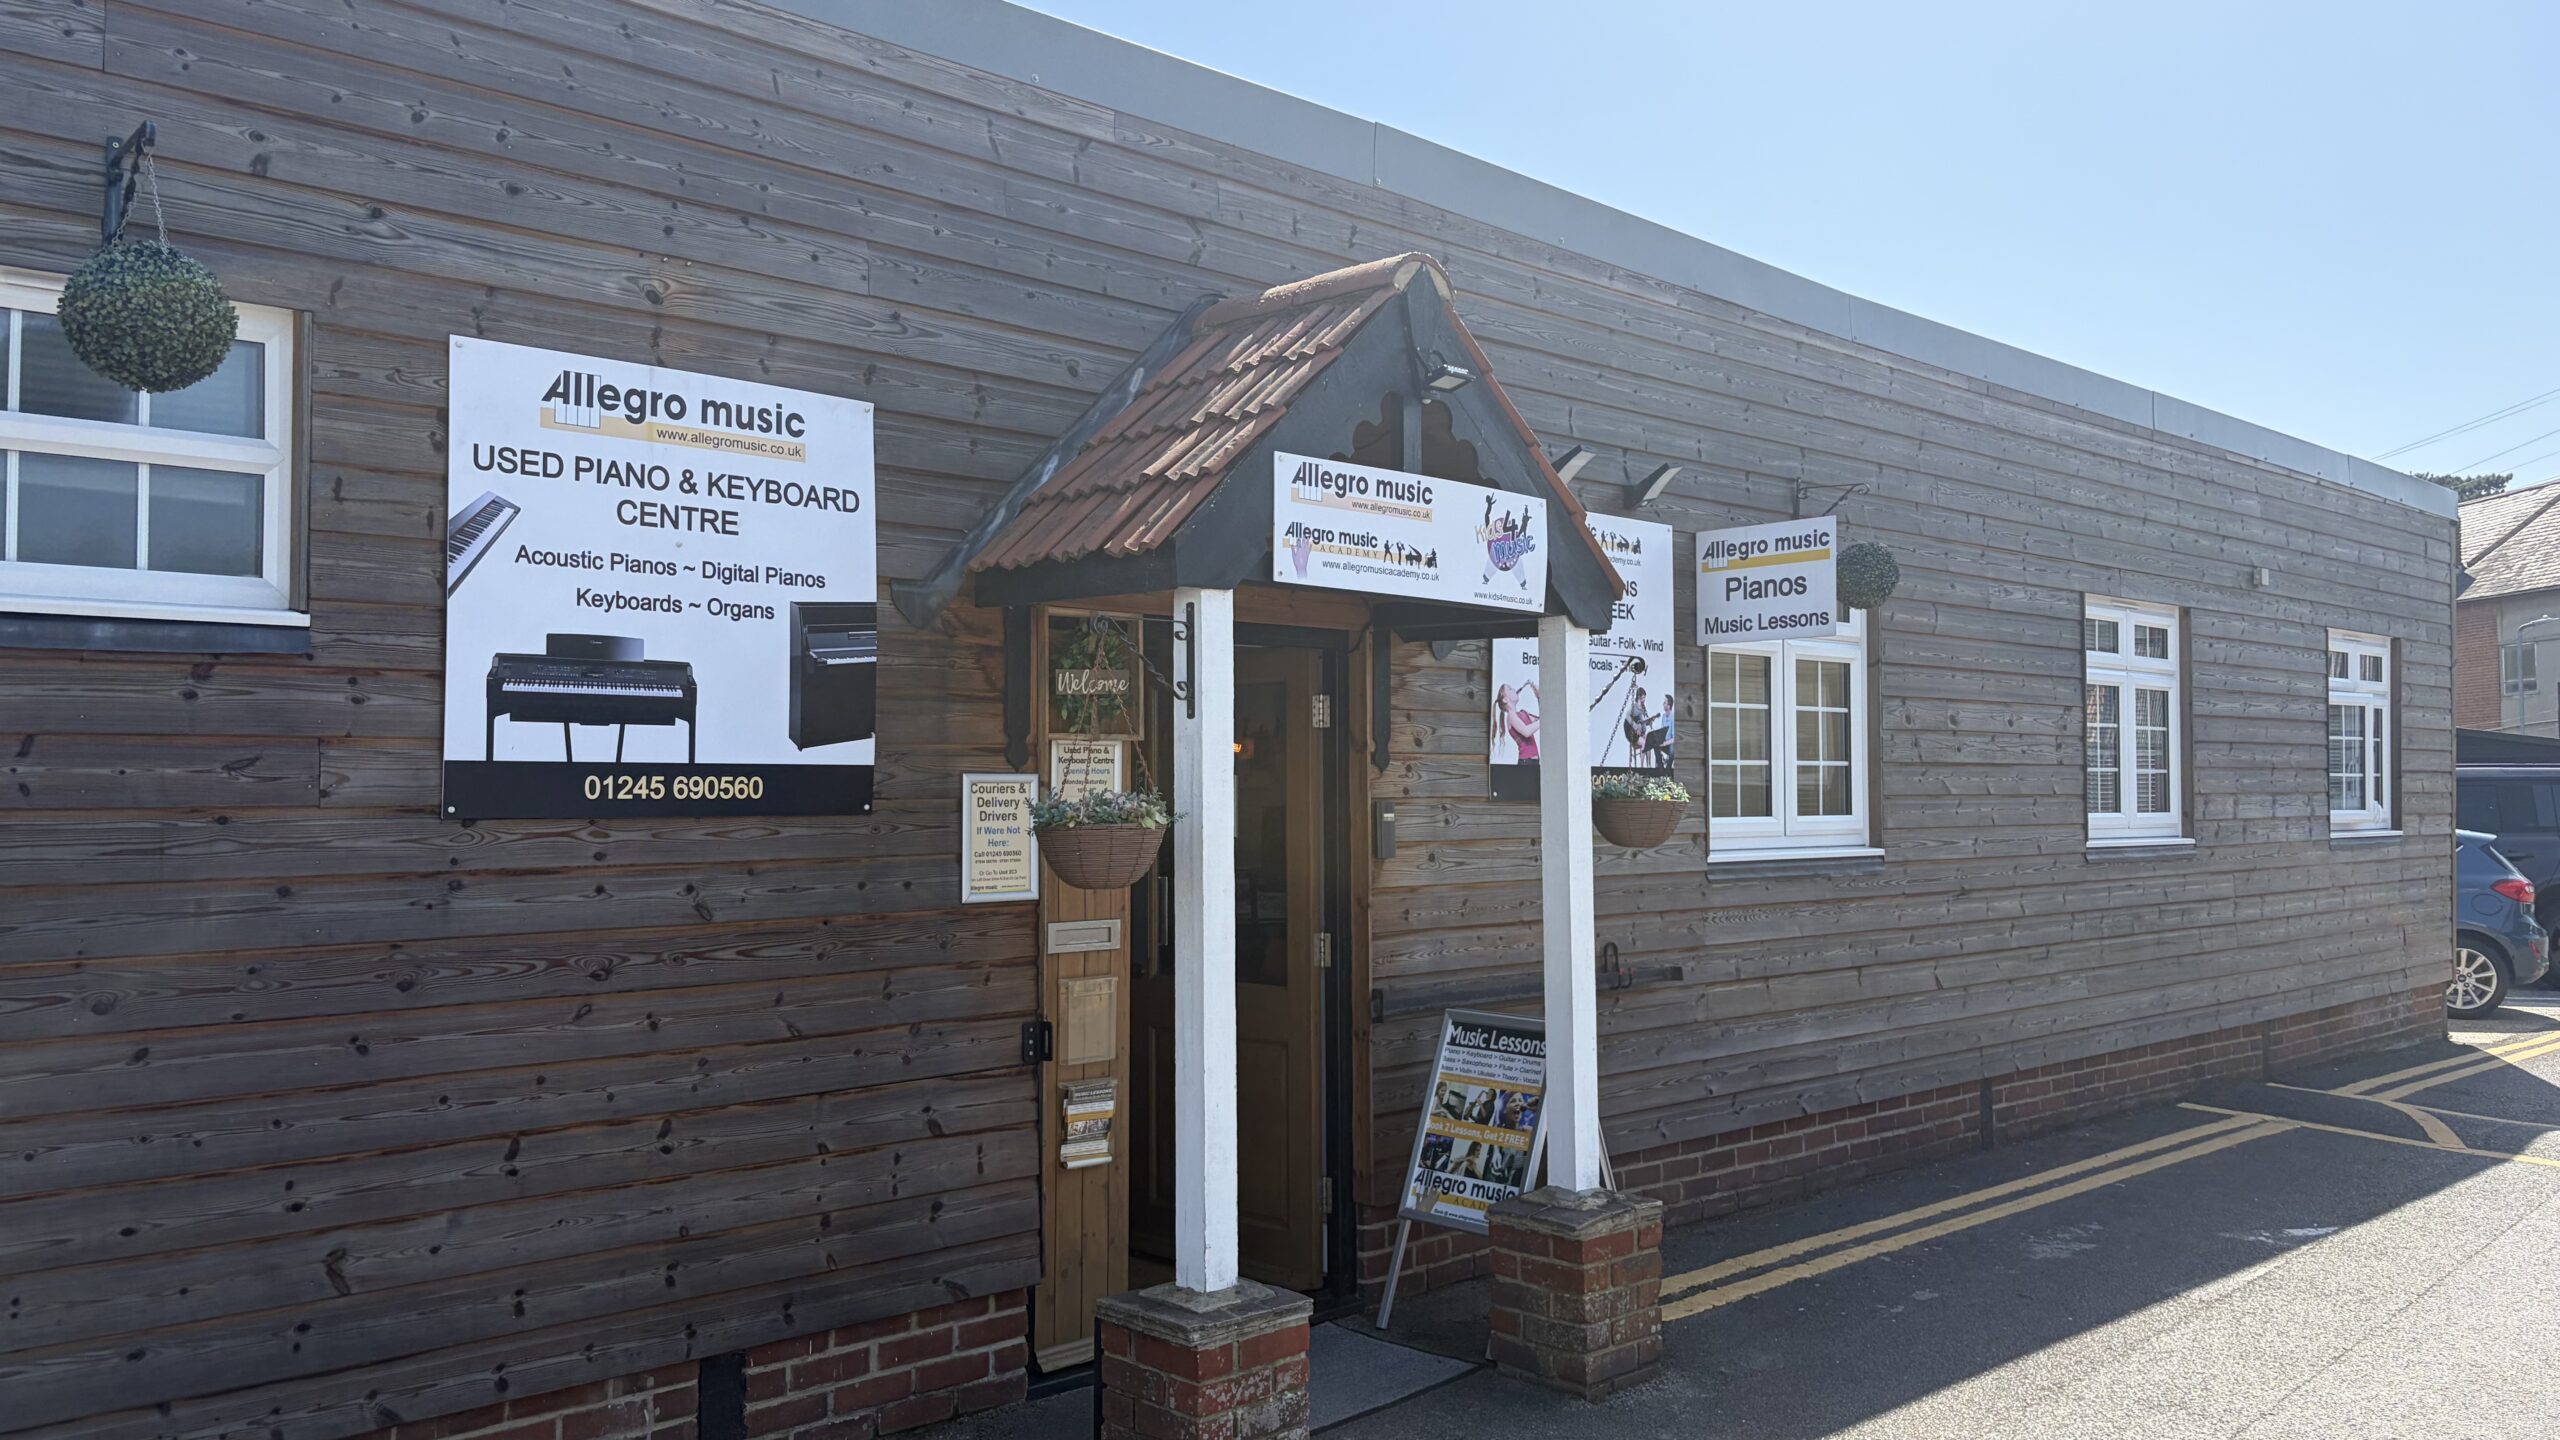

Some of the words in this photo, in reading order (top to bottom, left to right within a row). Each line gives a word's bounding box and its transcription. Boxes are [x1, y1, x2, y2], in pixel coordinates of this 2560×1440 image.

[541, 370, 687, 425] Allegro
[701, 394, 805, 438] music
[657, 427, 802, 459] www.allegromusic.co.uk
[472, 443, 564, 478] USED
[575, 456, 670, 491] PIANO
[679, 469, 698, 495] &
[707, 473, 860, 513] KEYBOARD
[1292, 461, 1368, 498] Allegro
[1376, 478, 1433, 505] music
[617, 500, 740, 536] CENTRE
[1352, 500, 1430, 519] www.allegromusic.co.uk
[1285, 521, 1335, 545] Allegro
[1339, 530, 1378, 549] music
[1502, 509, 1519, 541] 4
[1320, 545, 1378, 560] ACADEMY
[1492, 535, 1536, 561] music
[1703, 540, 1768, 560] Allegro
[1775, 529, 1830, 551] music
[515, 545, 604, 571] Acoustic
[610, 553, 677, 577] Pianos
[702, 561, 760, 585] Digital
[765, 568, 826, 589] Pianos
[1322, 560, 1440, 582] www.allegromusicacademy.co.uk
[1474, 592, 1533, 605] www.kids4music.co.uk
[1726, 576, 1807, 602] Pianos
[576, 588, 682, 614] Keyboards
[707, 601, 775, 622] Organs
[1612, 603, 1635, 620] EEK
[1705, 615, 1753, 635] Music
[1758, 612, 1829, 631] Lessons
[1619, 637, 1637, 649] Folk
[1643, 639, 1664, 652] Wind
[1058, 669, 1130, 695] Welcome
[1091, 767, 1110, 775] Hours
[1093, 756, 1115, 764] Centre
[584, 776, 665, 800] 01245
[673, 776, 764, 800] 690560
[971, 783, 1016, 794] Couriers
[1019, 783, 1027, 794] &
[977, 797, 1020, 809] Delivery
[980, 811, 1018, 821] Drivers
[977, 826, 982, 835] If
[984, 826, 1005, 835] Were
[1007, 826, 1021, 834] Not
[988, 839, 1009, 847] Here:
[1448, 1025, 1489, 1047] Music
[1490, 1030, 1546, 1056] Lessons
[1414, 1169, 1467, 1195] Allegro
